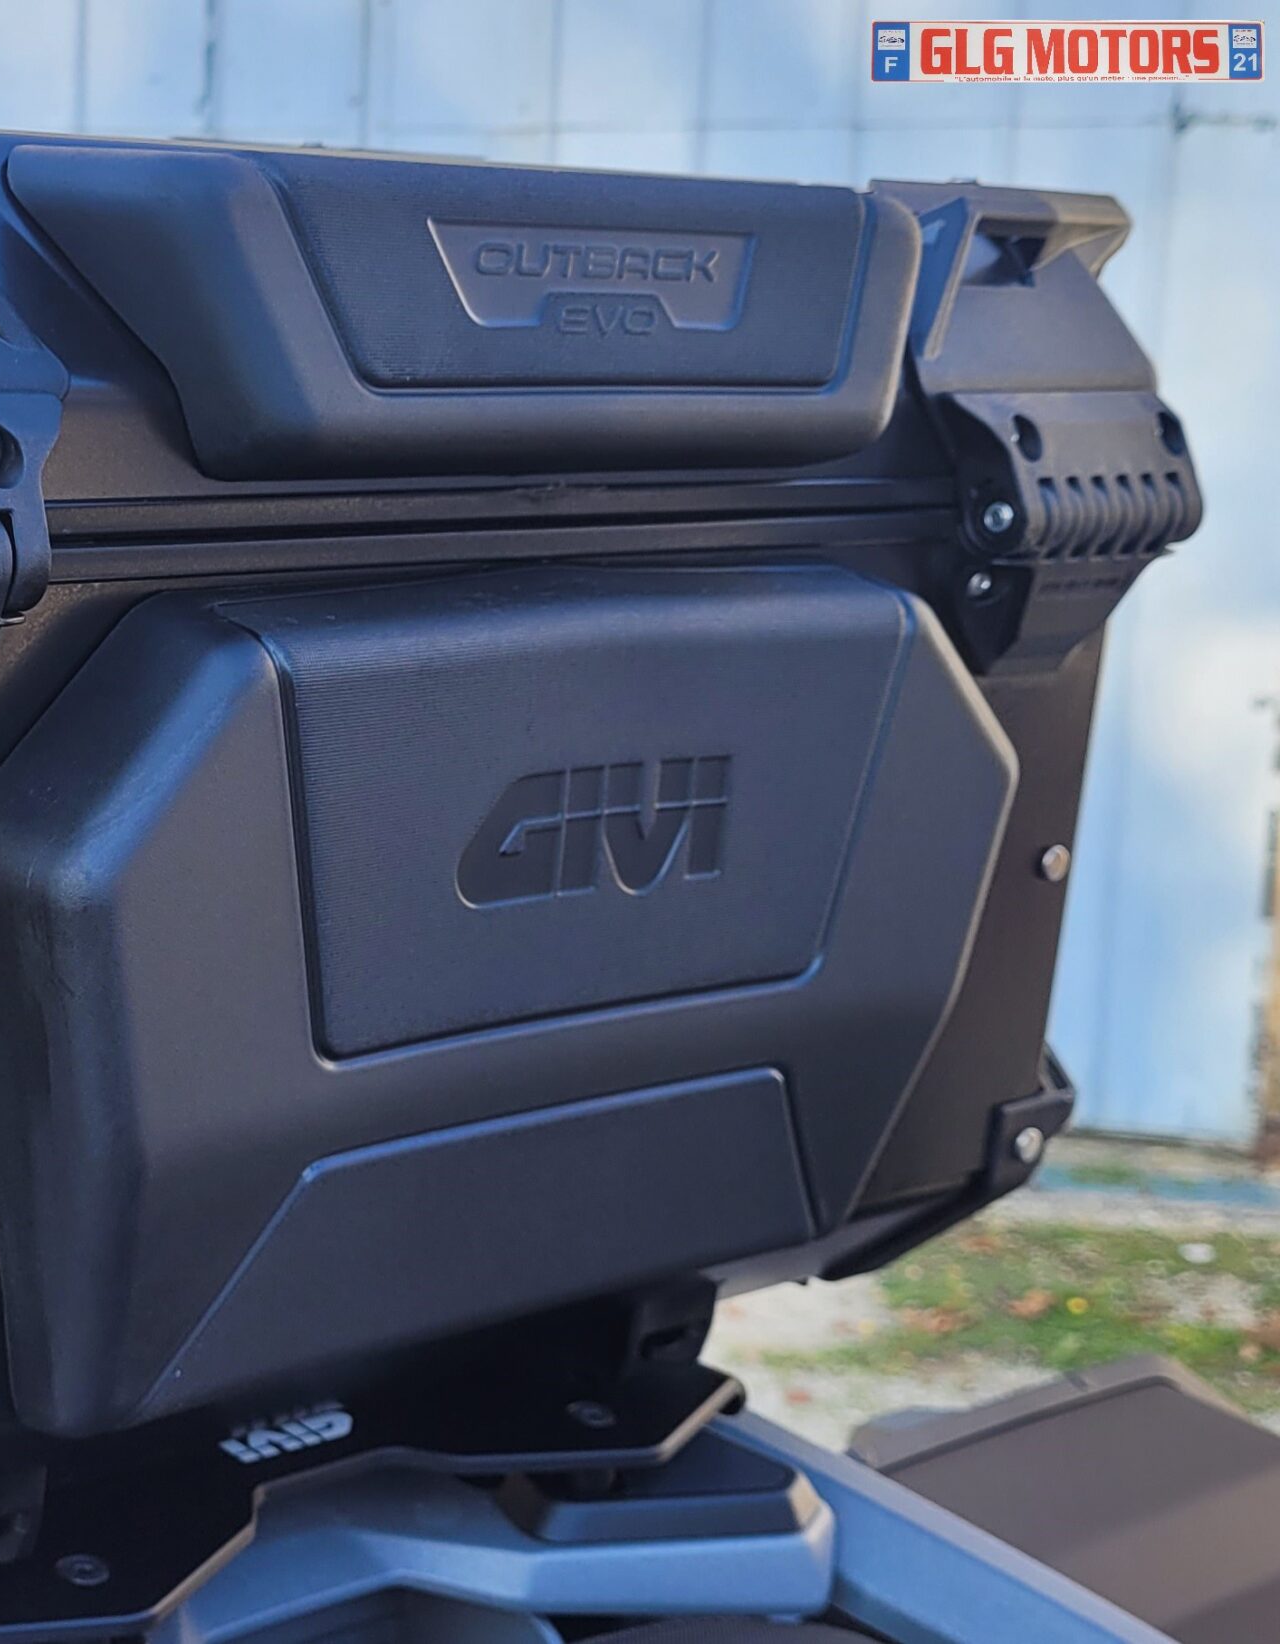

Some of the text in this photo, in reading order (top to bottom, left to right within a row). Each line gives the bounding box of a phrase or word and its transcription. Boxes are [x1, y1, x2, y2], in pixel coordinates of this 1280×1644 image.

[474, 241, 720, 283] OUTBACK
[557, 304, 658, 337] EVO
[454, 754, 732, 909] GIVI
